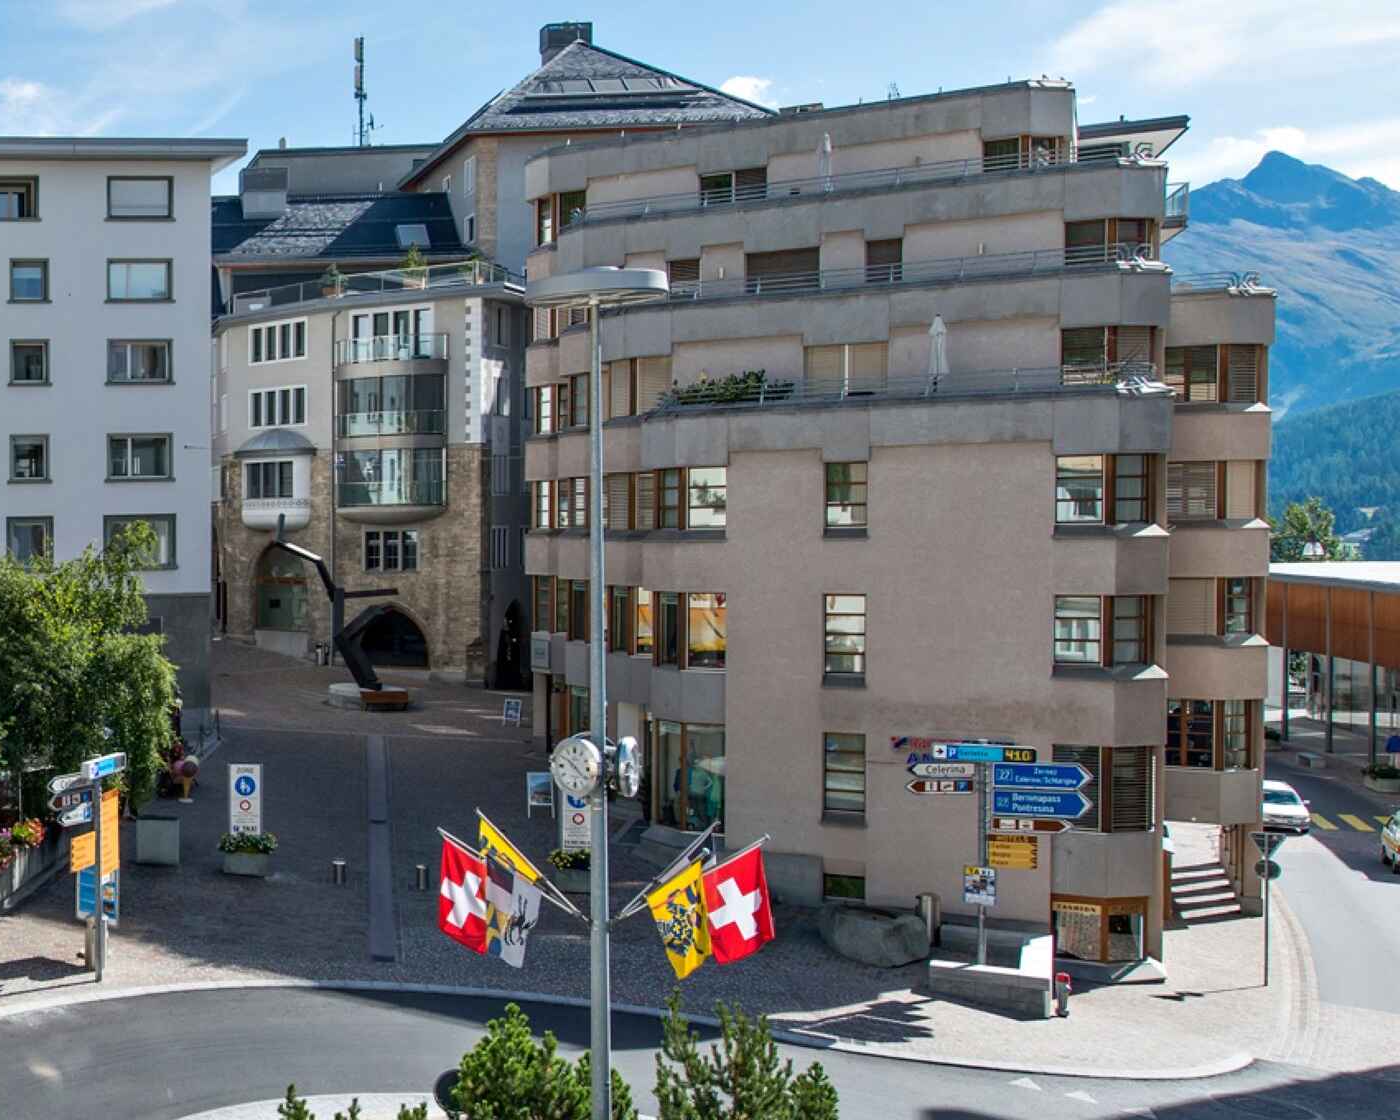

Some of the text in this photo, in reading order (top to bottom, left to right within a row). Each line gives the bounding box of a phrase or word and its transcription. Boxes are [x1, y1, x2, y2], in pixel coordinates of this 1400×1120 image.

[1005, 749, 1031, 761] 410
[925, 765, 966, 775] Celerina
[1012, 803, 1055, 813] Pontresina
[967, 866, 991, 876] TAXI
